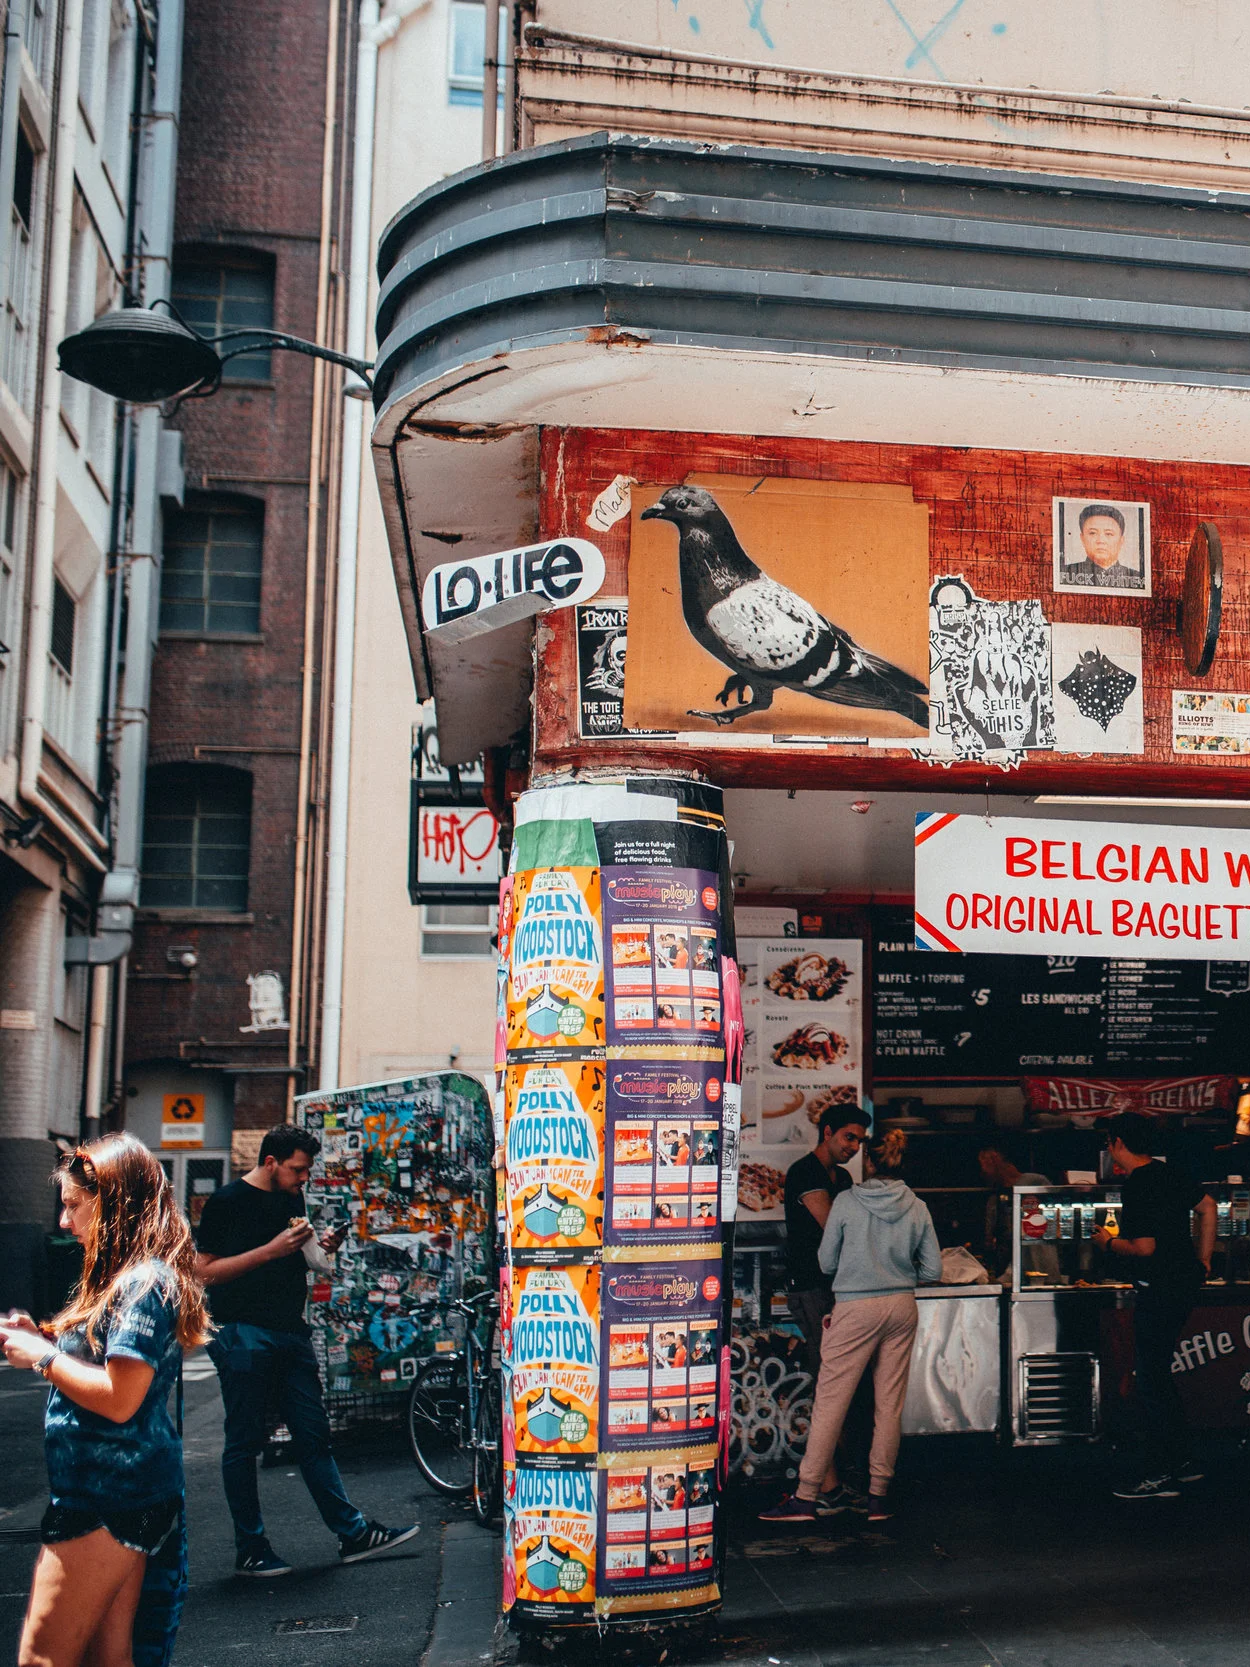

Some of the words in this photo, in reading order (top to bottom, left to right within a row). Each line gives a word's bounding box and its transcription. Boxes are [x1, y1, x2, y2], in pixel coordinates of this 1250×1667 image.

[1060, 571, 1094, 585] FUCK
[581, 610, 618, 628] IRON
[582, 702, 598, 713] THE
[600, 702, 620, 713] TOTE
[983, 698, 1021, 711] SELFIE
[986, 714, 1024, 733] THIS
[650, 840, 660, 848] full
[629, 856, 652, 864] flowing
[1005, 837, 1209, 885] BELGIAN
[524, 894, 582, 917] POLLY
[944, 892, 1103, 937] ORIGINAL
[514, 919, 600, 966] WOODSTOCK
[878, 942, 905, 952] PLAIN
[878, 974, 911, 983] WAFFLE
[928, 974, 965, 984] TOPPING
[1021, 994, 1040, 1004] LES
[1042, 994, 1101, 1004] SANDWICHES
[562, 1007, 581, 1017] KIDS
[557, 1017, 584, 1026] ENTER
[559, 1025, 581, 1036] FREE
[876, 1030, 893, 1038] HOT
[896, 1030, 922, 1038] DRINK
[884, 1047, 910, 1055] PLAIN
[913, 1047, 945, 1055] WAFFLE
[1019, 1055, 1054, 1065] CATERING
[1057, 1055, 1094, 1065] AVAILABLE
[1047, 1080, 1113, 1110] ALLEZ
[1150, 1078, 1220, 1107] REIMS
[516, 1090, 575, 1113] POLLY
[508, 1116, 596, 1164] WOODSTOCK
[562, 1207, 581, 1217] KIDS
[557, 1217, 586, 1226] ENTER
[559, 1225, 583, 1236] FREE
[519, 1294, 581, 1317] POLLY
[564, 1413, 584, 1422] KIDS
[560, 1422, 588, 1431] ENTER
[562, 1430, 583, 1441] FREE
[562, 1562, 582, 1572] KIDS
[559, 1571, 586, 1580] ENTER
[560, 1580, 583, 1591] FREE
